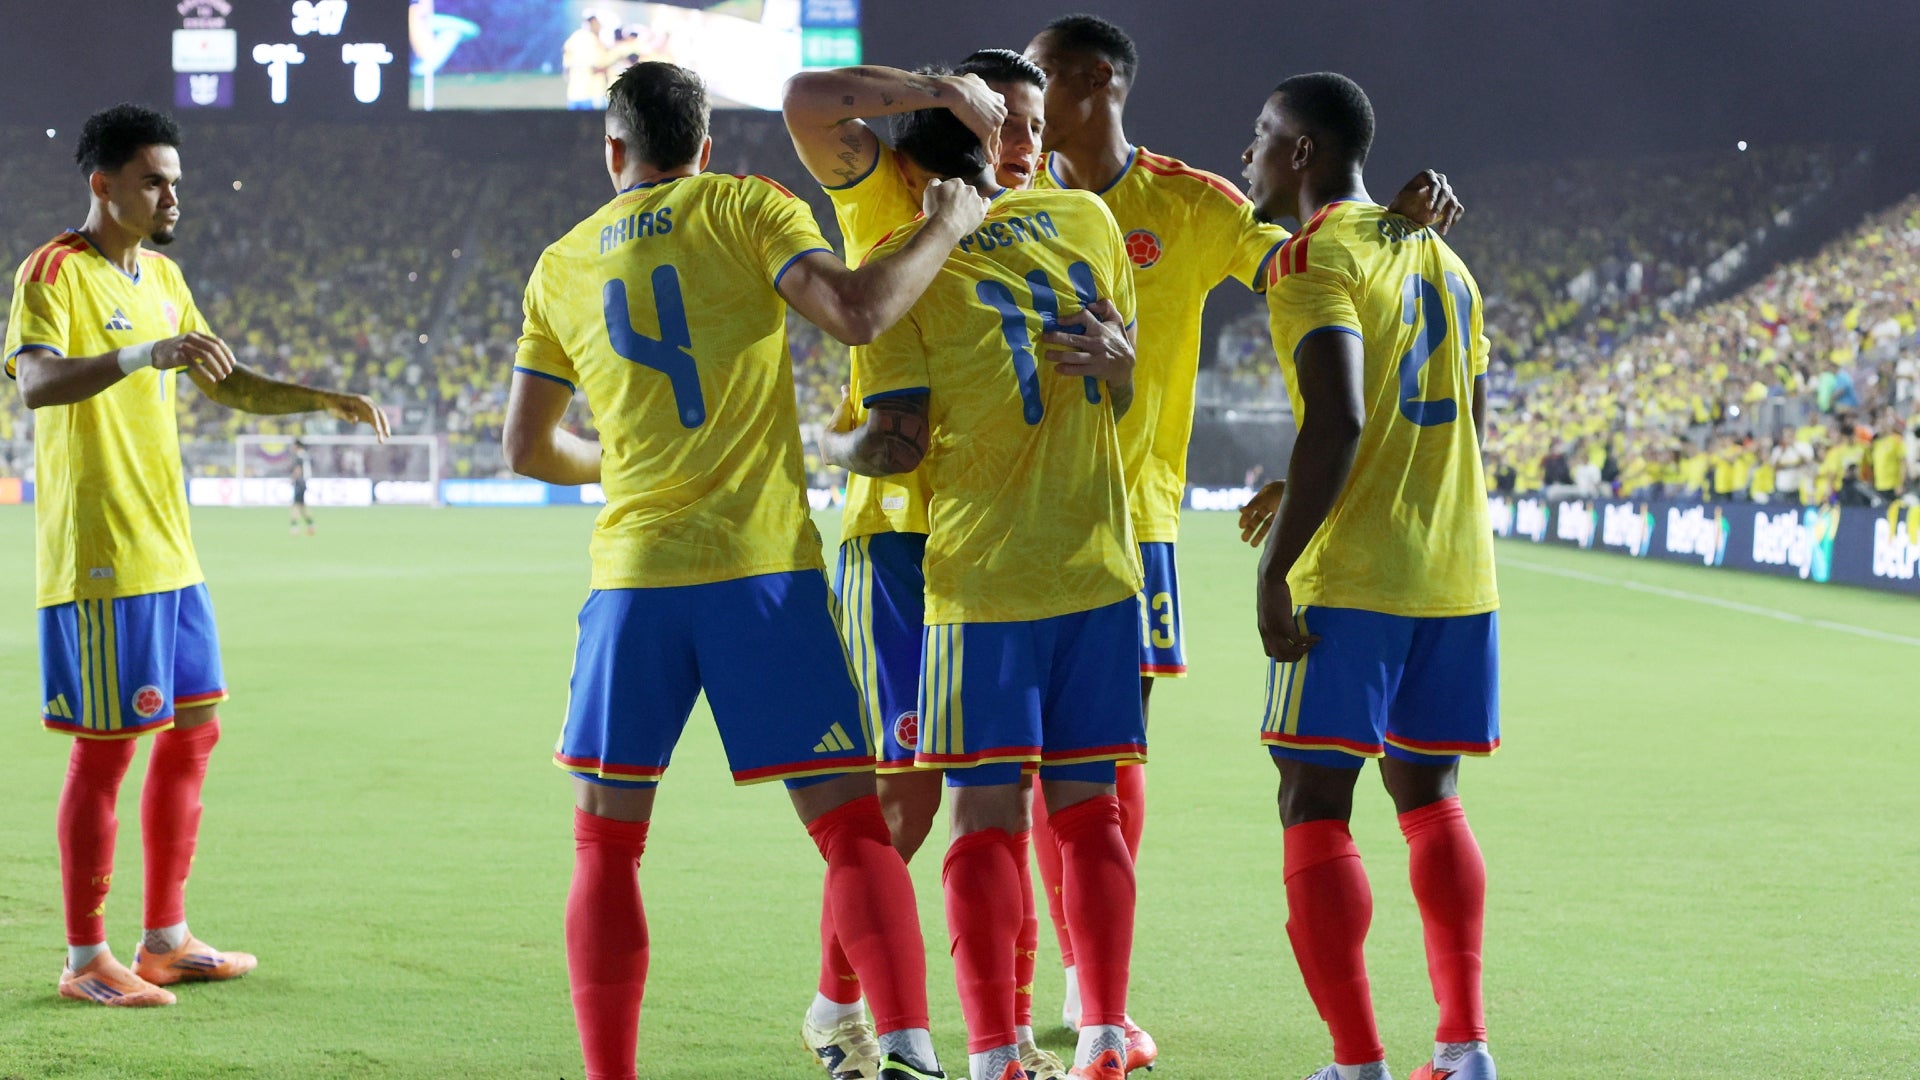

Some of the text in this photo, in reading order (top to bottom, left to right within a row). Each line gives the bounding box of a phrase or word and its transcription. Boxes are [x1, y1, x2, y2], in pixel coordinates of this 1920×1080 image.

[600, 207, 673, 255] ARIAS
[958, 211, 1059, 253] PUERTA
[603, 264, 706, 428] 4
[976, 260, 1102, 426] 14
[1191, 487, 1258, 511] BetPl
[1873, 518, 1920, 580] BetP
[1136, 591, 1175, 649] 13
